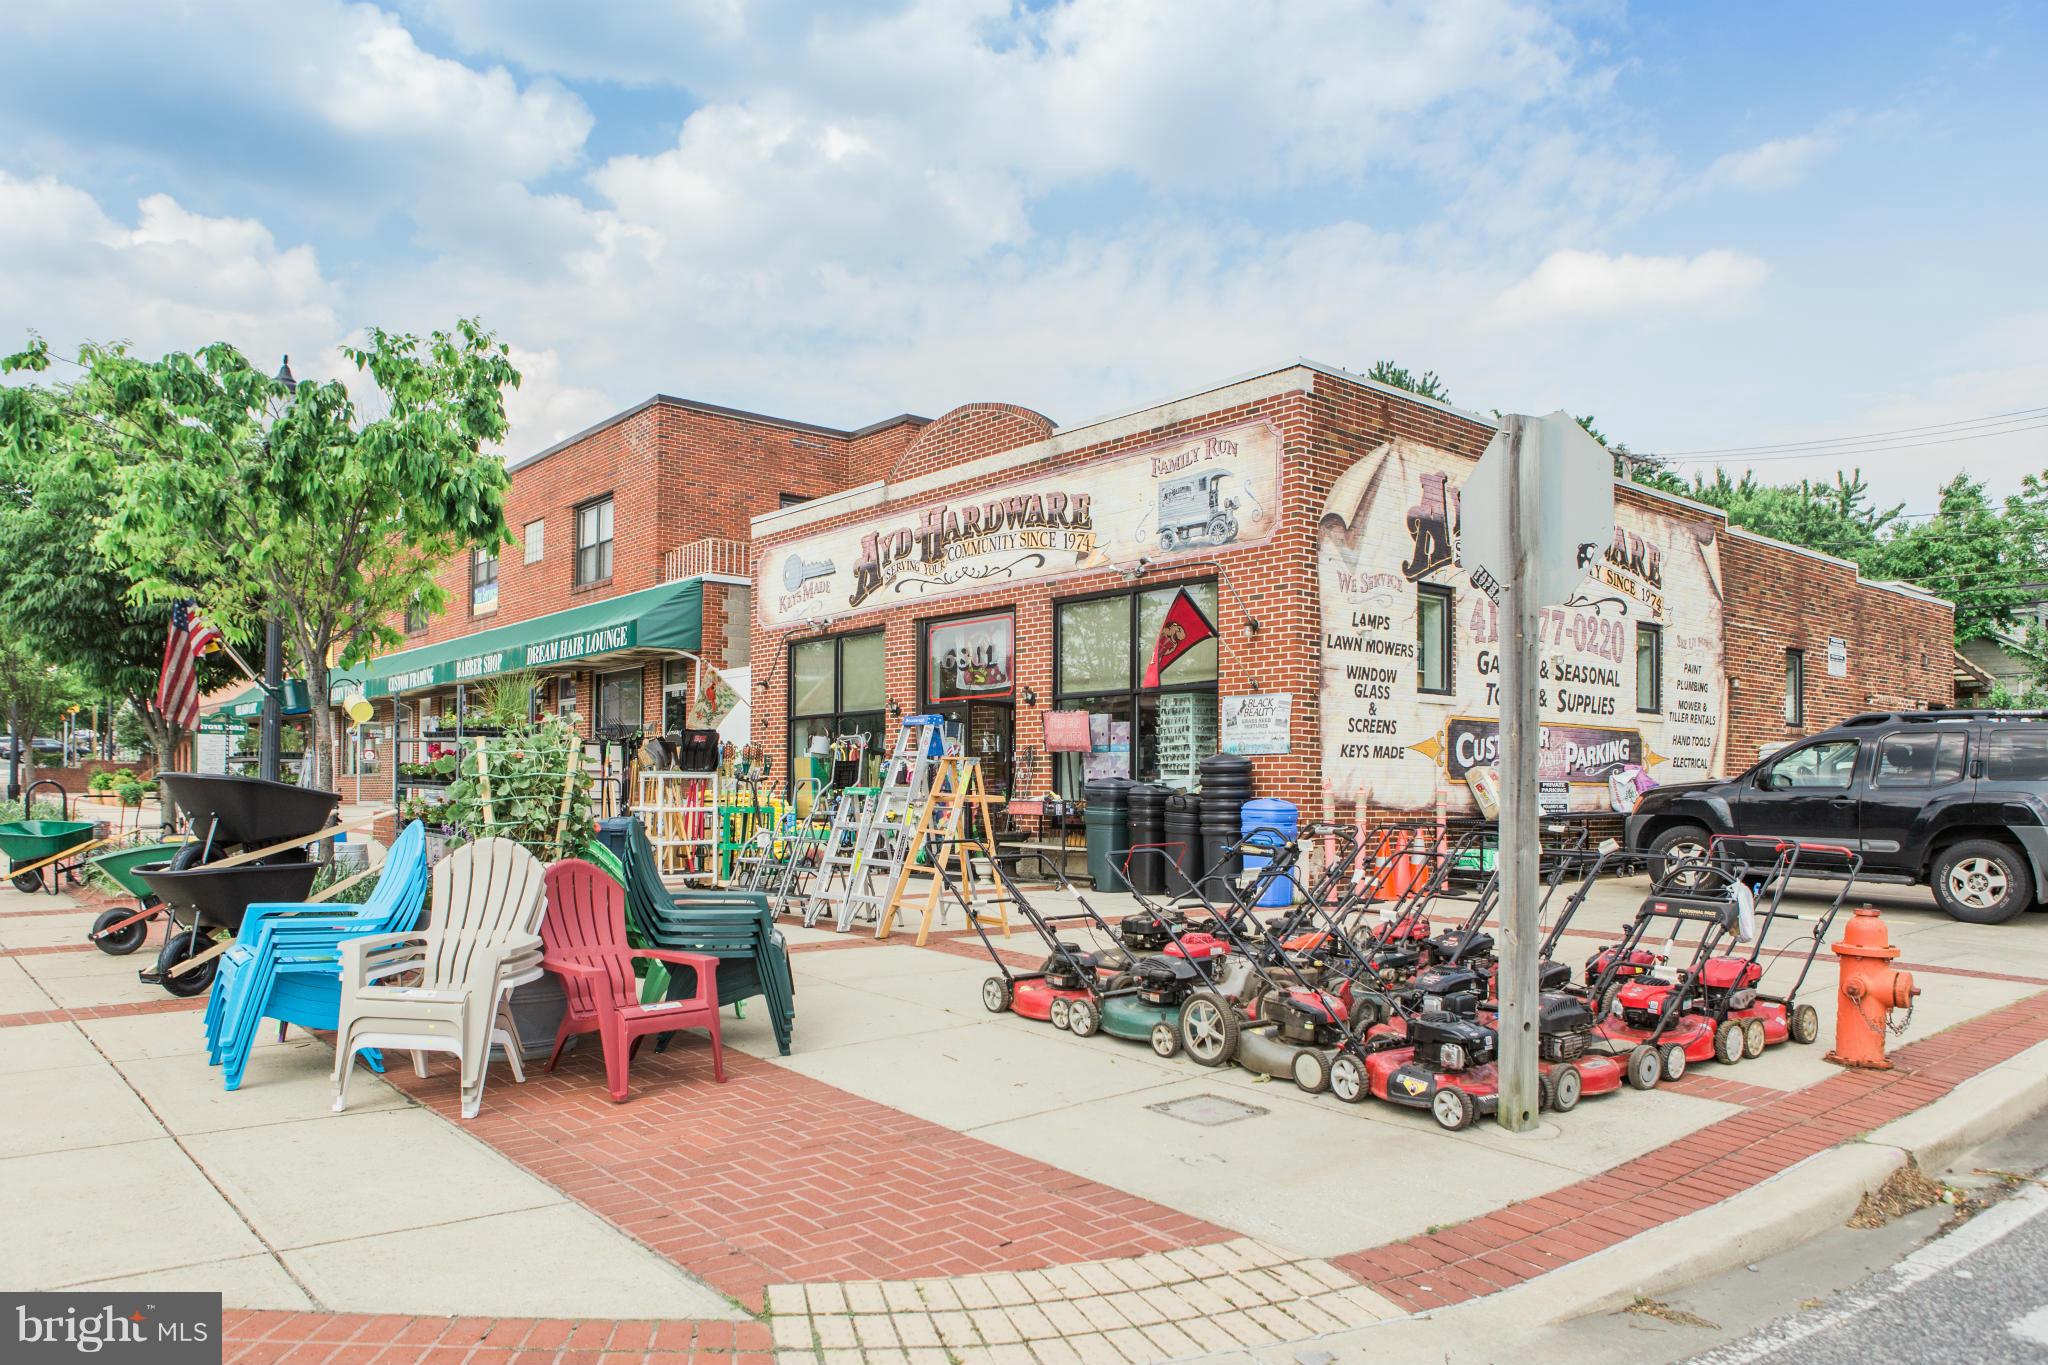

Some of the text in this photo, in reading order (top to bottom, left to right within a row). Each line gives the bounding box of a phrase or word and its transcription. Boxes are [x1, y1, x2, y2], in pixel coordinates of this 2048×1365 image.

[1151, 437, 1239, 478] FAMILY RUN
[915, 491, 1094, 567] HARDWARE
[885, 531, 1092, 580] SERVING YOUR COMMUNITY SINCE 1974
[1337, 569, 1404, 594] WE SERVICE
[1606, 569, 1636, 596] SINCE
[1641, 588, 1662, 611] 1974
[778, 580, 831, 614] KEYS MADE
[1351, 611, 1391, 630] LAMPS
[526, 625, 628, 666] DREAM HAIR LOUNGE
[1327, 633, 1414, 658] LAWN MOWERS
[456, 653, 502, 678] BARBER SHOP
[1346, 664, 1398, 684] WINDOW
[1539, 660, 1620, 688] & SEASONAL
[1683, 663, 1702, 675] PAINT
[388, 674, 409, 692] CUSTOM
[409, 667, 434, 688] FRAMING
[1676, 679, 1709, 693] PLUMBING
[1354, 683, 1391, 700] GLASS
[1244, 706, 1277, 718] BEAUTY
[1247, 697, 1274, 708] BLACK
[1368, 701, 1377, 716] &
[1538, 688, 1616, 716] & SUPPLIES
[1678, 699, 1708, 712] MOWER &
[1347, 717, 1397, 735] SCREENS
[1669, 711, 1716, 726] TILLER RENTALS
[1672, 734, 1711, 748] HAND TOOLS
[1340, 743, 1405, 760] KEYS MADE
[1565, 738, 1630, 775] PARKING
[1672, 756, 1708, 770] ELECTRICAL
